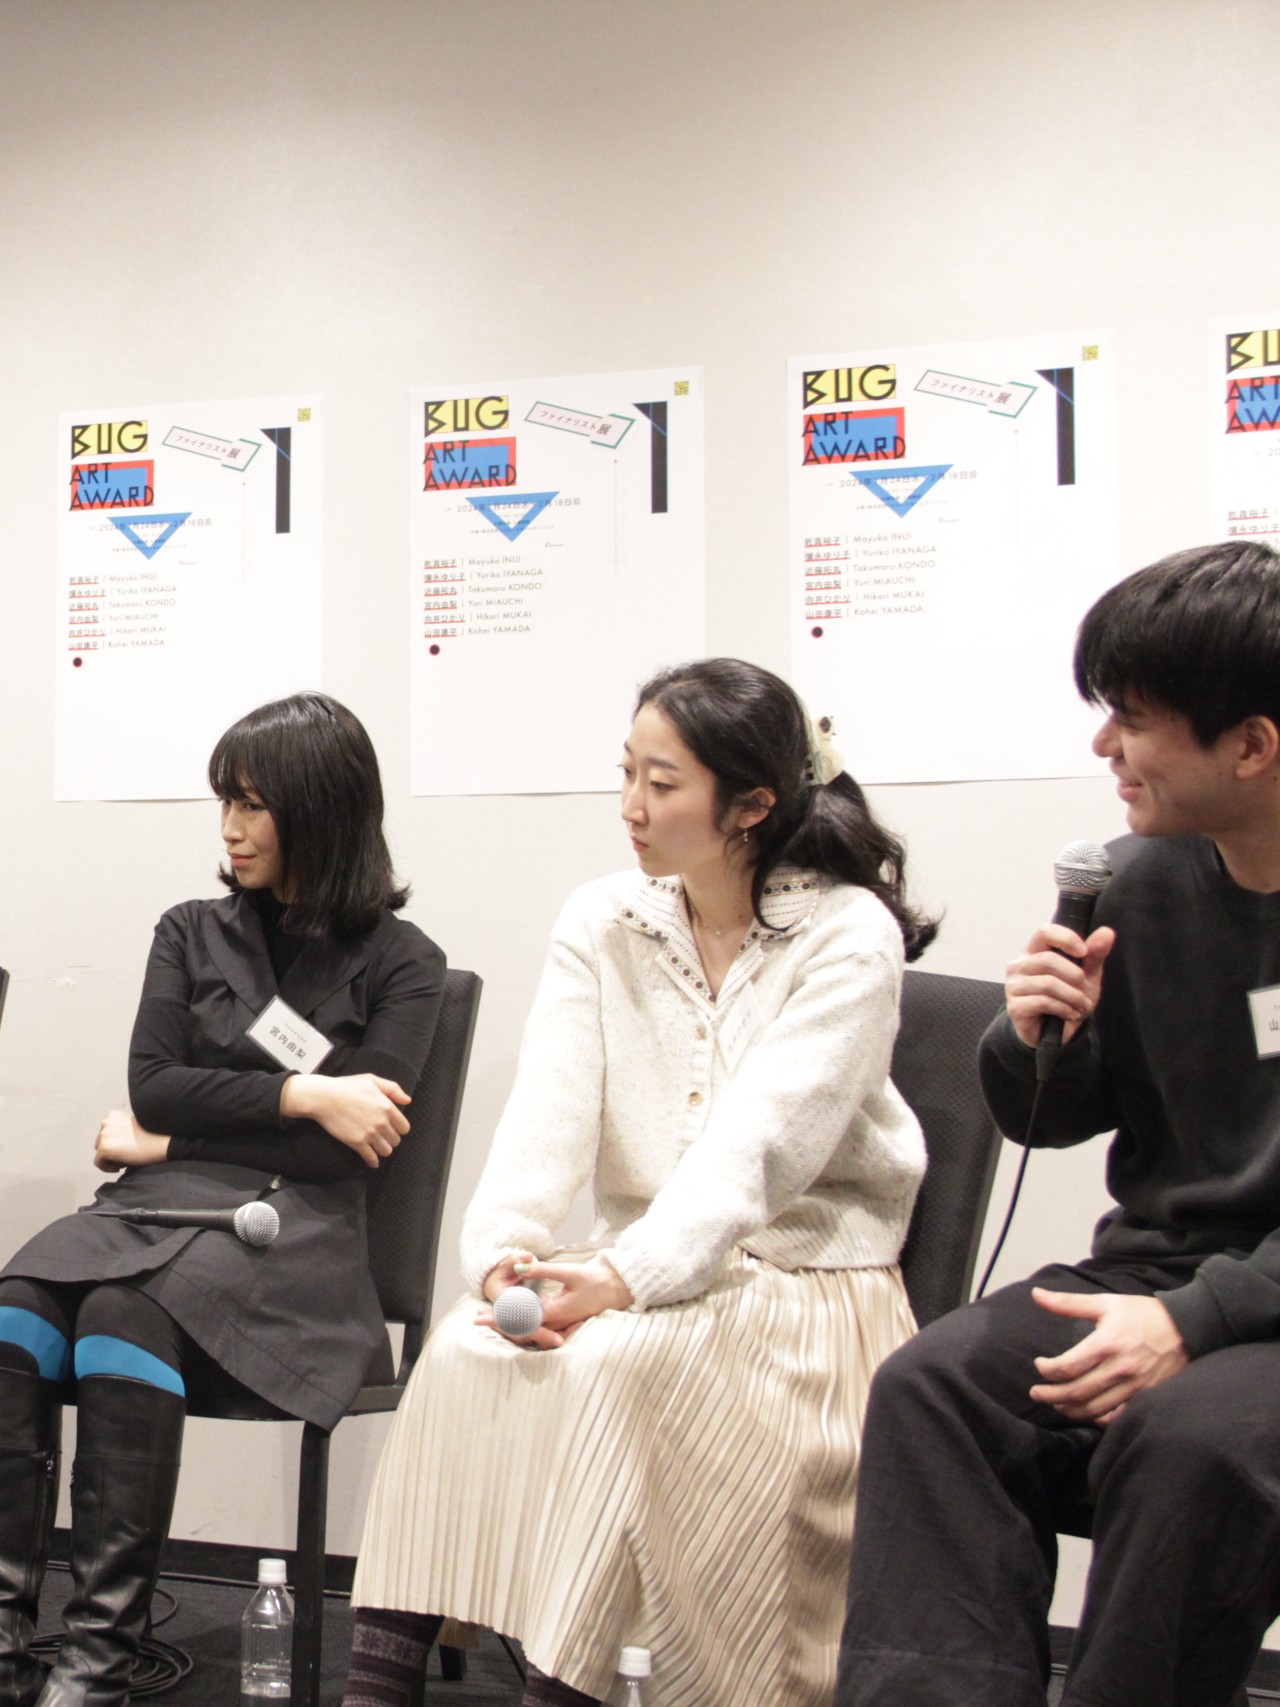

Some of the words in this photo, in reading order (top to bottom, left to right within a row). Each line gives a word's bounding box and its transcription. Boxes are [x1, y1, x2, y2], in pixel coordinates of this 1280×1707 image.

[802, 364, 897, 411] BUG
[424, 395, 509, 439] BUG
[801, 411, 853, 438] ART
[71, 420, 149, 461] BUG
[422, 440, 470, 464] ART
[801, 435, 906, 467] AWARD
[69, 462, 112, 486] ART
[422, 463, 517, 492] AWARD
[69, 485, 155, 512] AWARD
